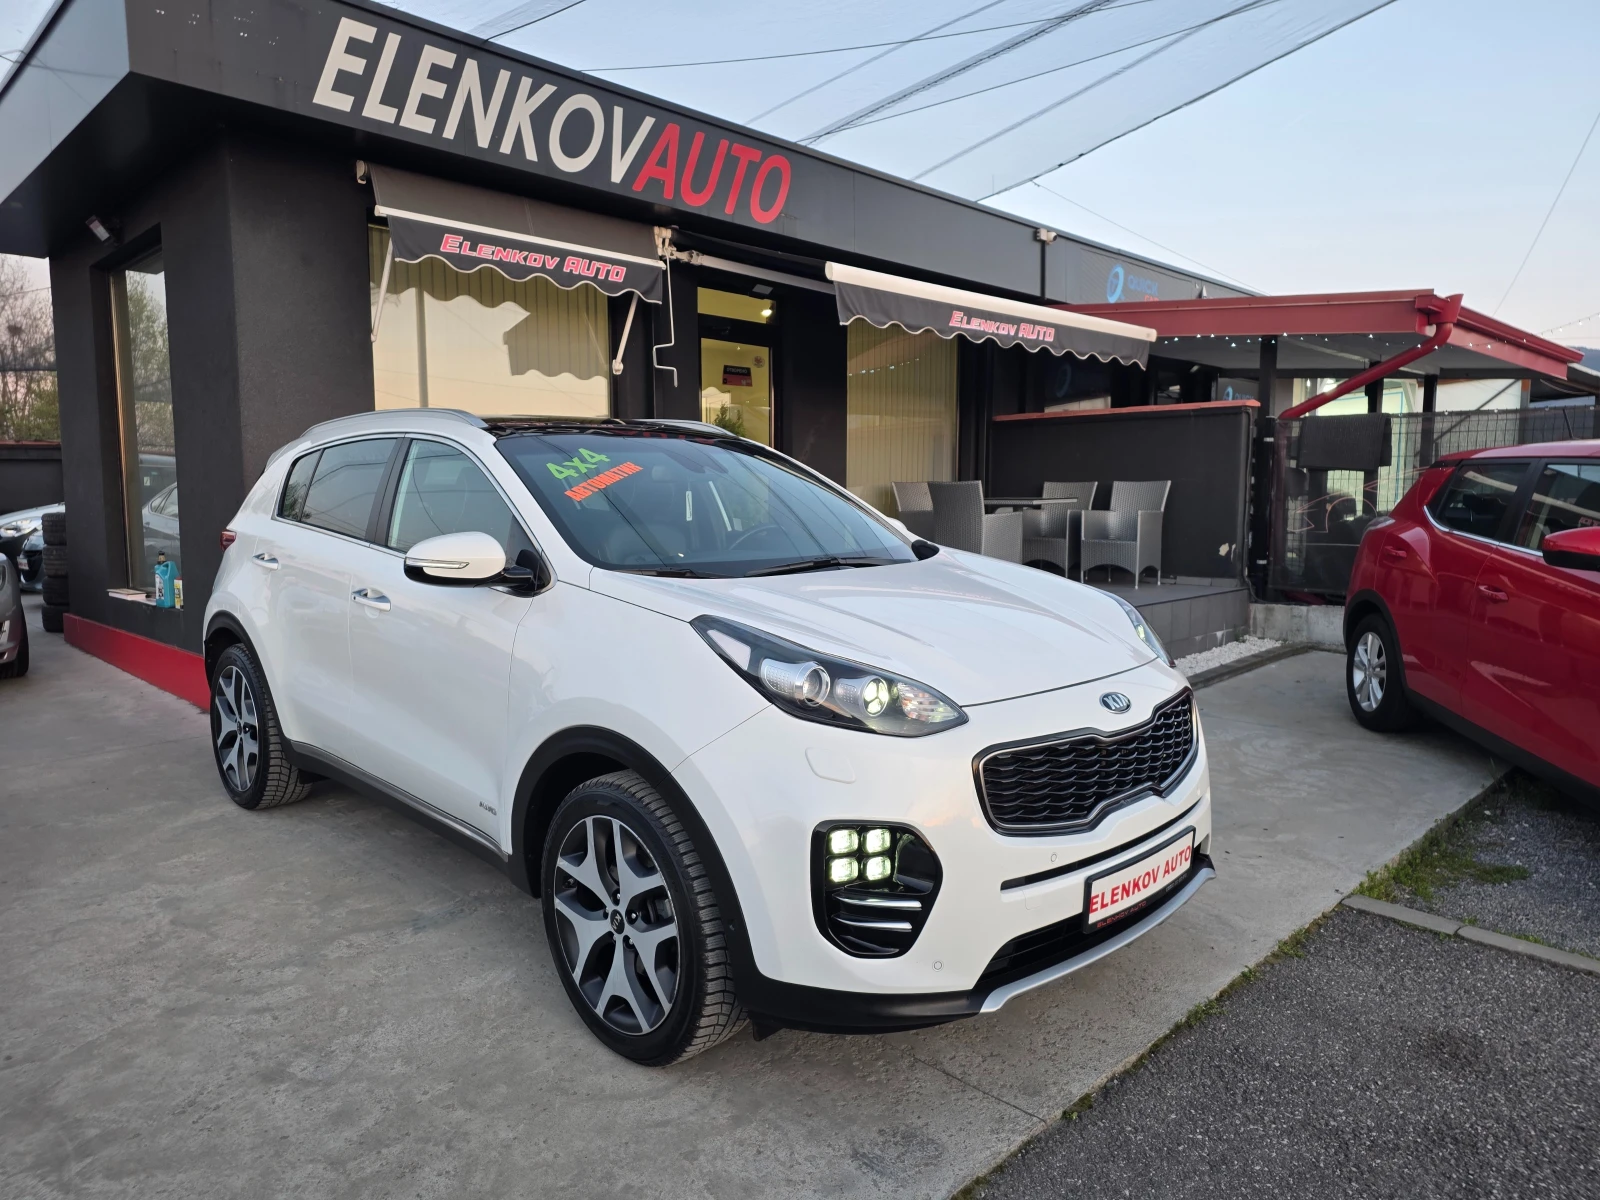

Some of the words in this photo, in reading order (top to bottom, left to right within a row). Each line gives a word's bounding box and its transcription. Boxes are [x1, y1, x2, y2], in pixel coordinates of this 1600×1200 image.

[440, 233, 560, 270] ELENKOV
[563, 255, 627, 283] AUTO
[1127, 275, 1158, 296] QUICK
[949, 310, 1017, 336] ELENKOV
[1018, 322, 1055, 342] AUTO
[546, 447, 611, 480] 4x4
[563, 460, 644, 502] АВТОМАТИК
[1102, 693, 1130, 710] KIA
[1088, 864, 1161, 915] ELENKOV
[1162, 845, 1192, 879] AUTO
[612, 913, 621, 930] KIA
